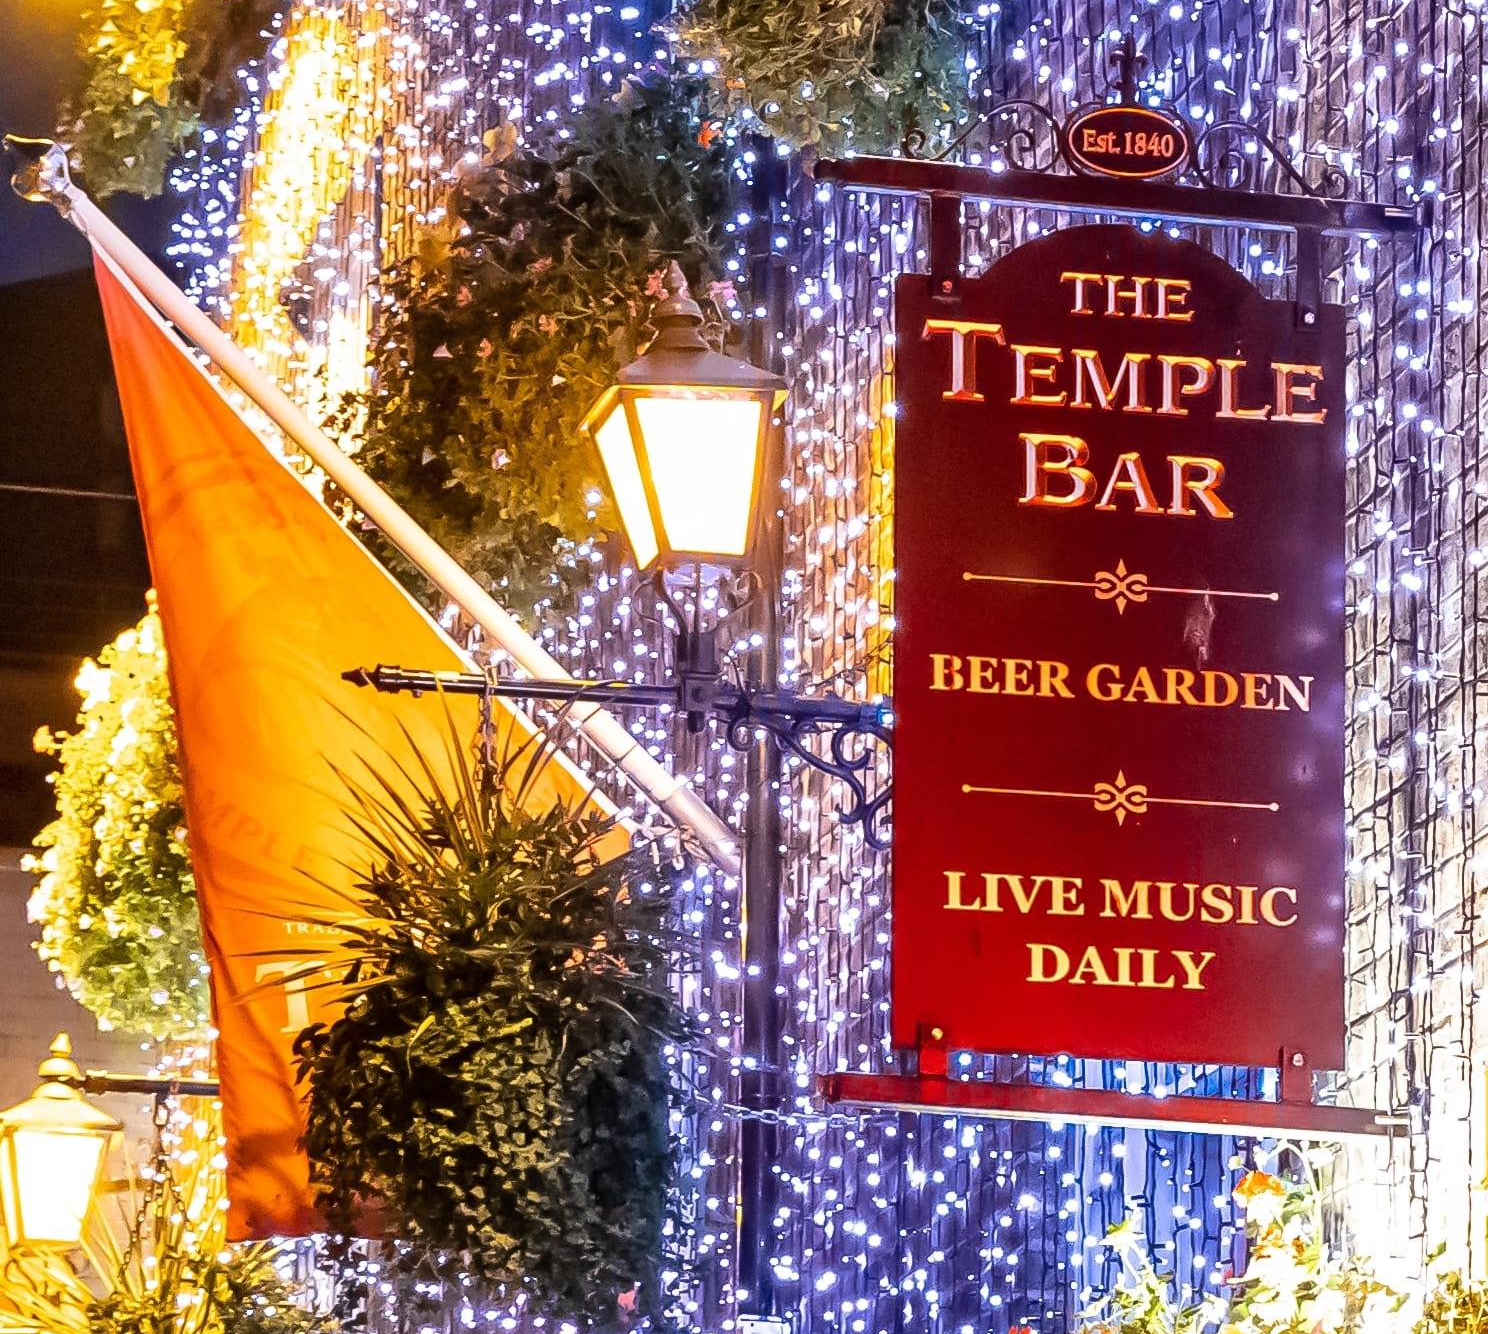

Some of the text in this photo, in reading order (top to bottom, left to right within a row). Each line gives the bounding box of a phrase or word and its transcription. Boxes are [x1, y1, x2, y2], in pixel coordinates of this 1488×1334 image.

[1124, 132, 1174, 157] 1840
[1060, 271, 1195, 322] THE
[922, 318, 1328, 425] TEMPLE
[1018, 432, 1235, 520] BAR
[929, 653, 1316, 713] BEER GARDEN
[943, 871, 1299, 927] LIVE MUSIC
[1026, 943, 1217, 990] DAILY
